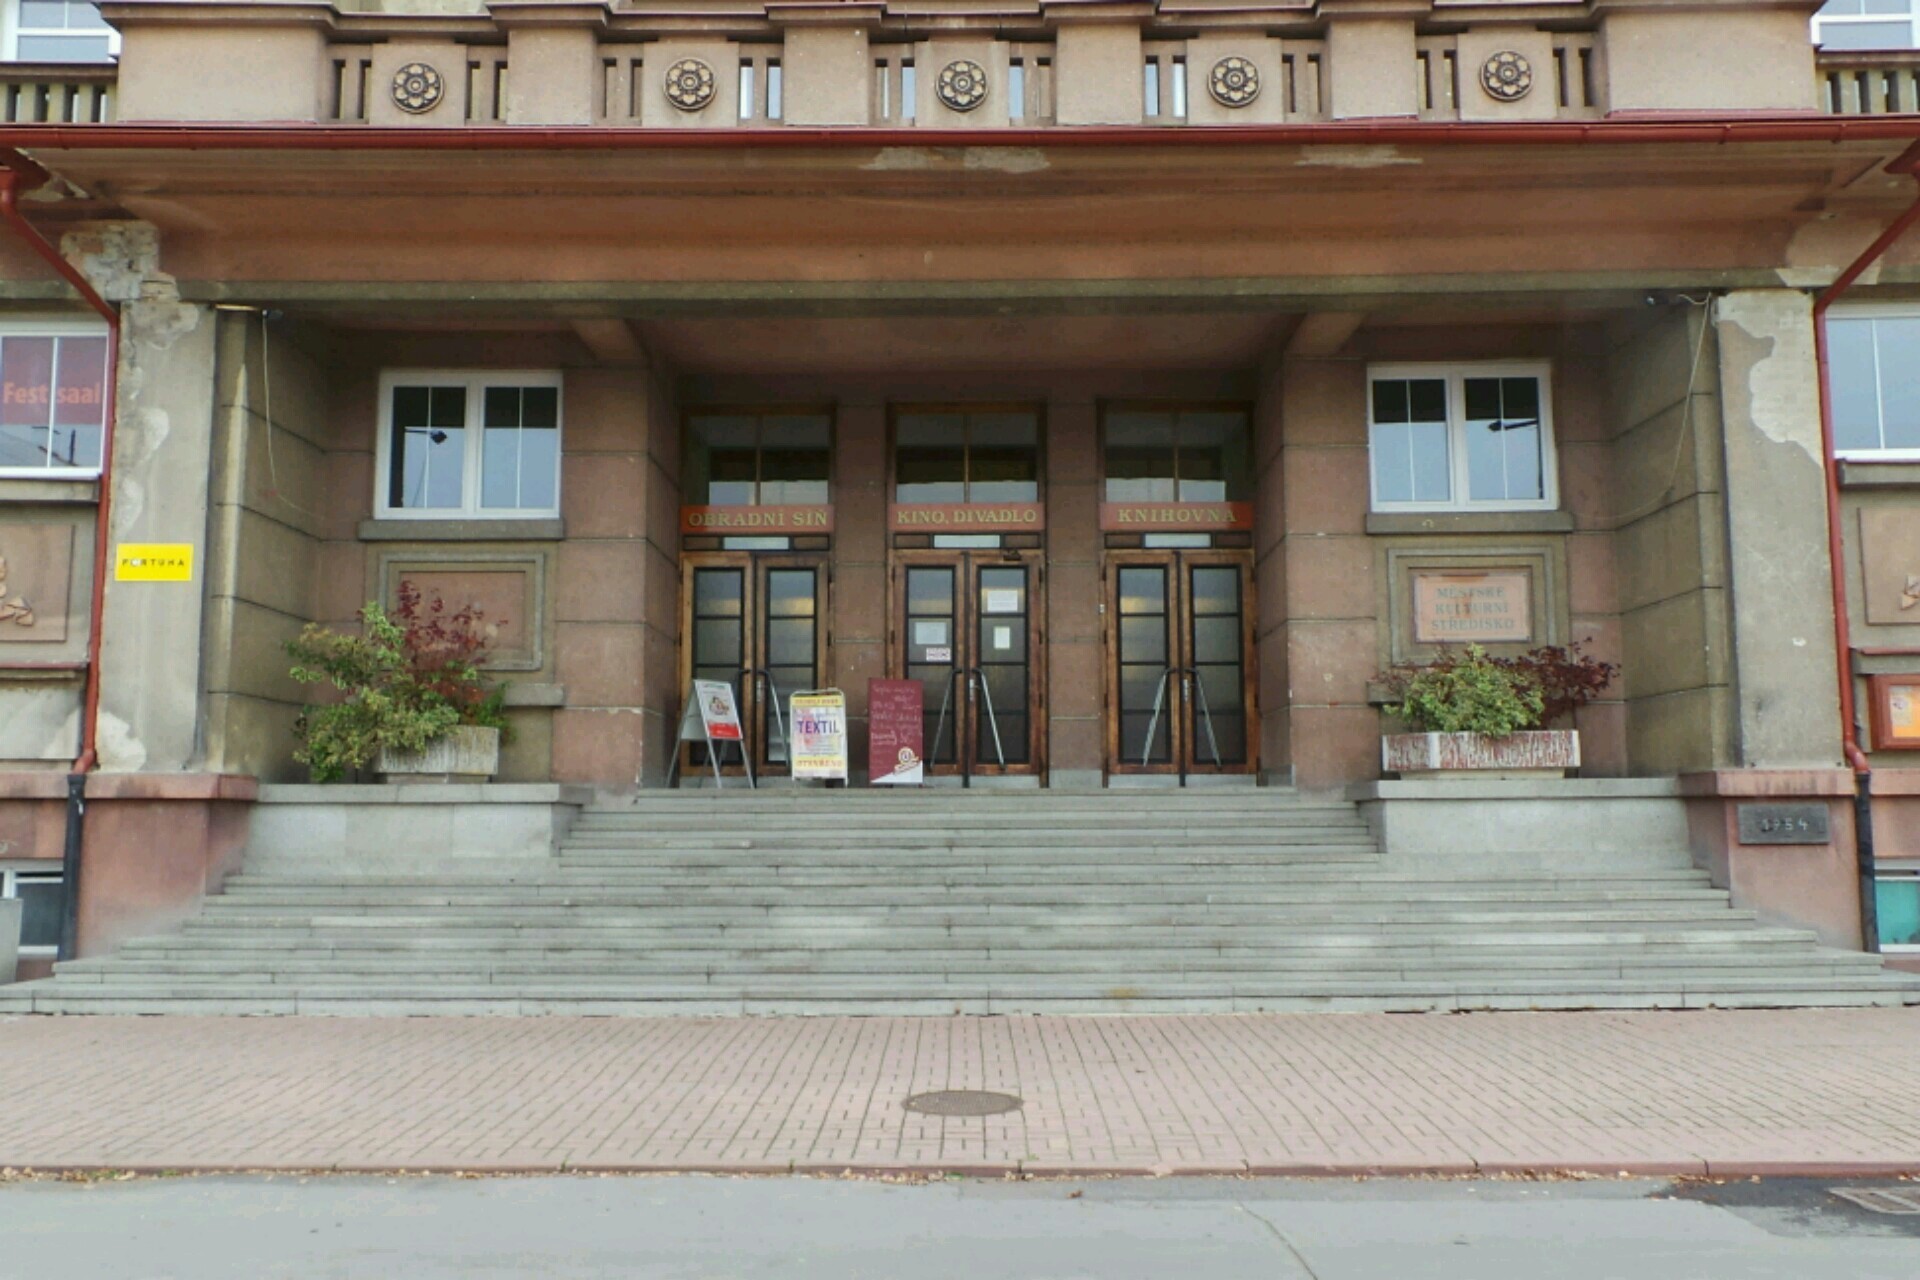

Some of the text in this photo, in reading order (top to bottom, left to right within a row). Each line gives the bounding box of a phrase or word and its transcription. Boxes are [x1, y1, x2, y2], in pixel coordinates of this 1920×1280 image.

[953, 508, 1037, 523] DIVADLO
[1117, 508, 1237, 523] KNIHOVNA
[797, 720, 840, 734] TEXTIL
